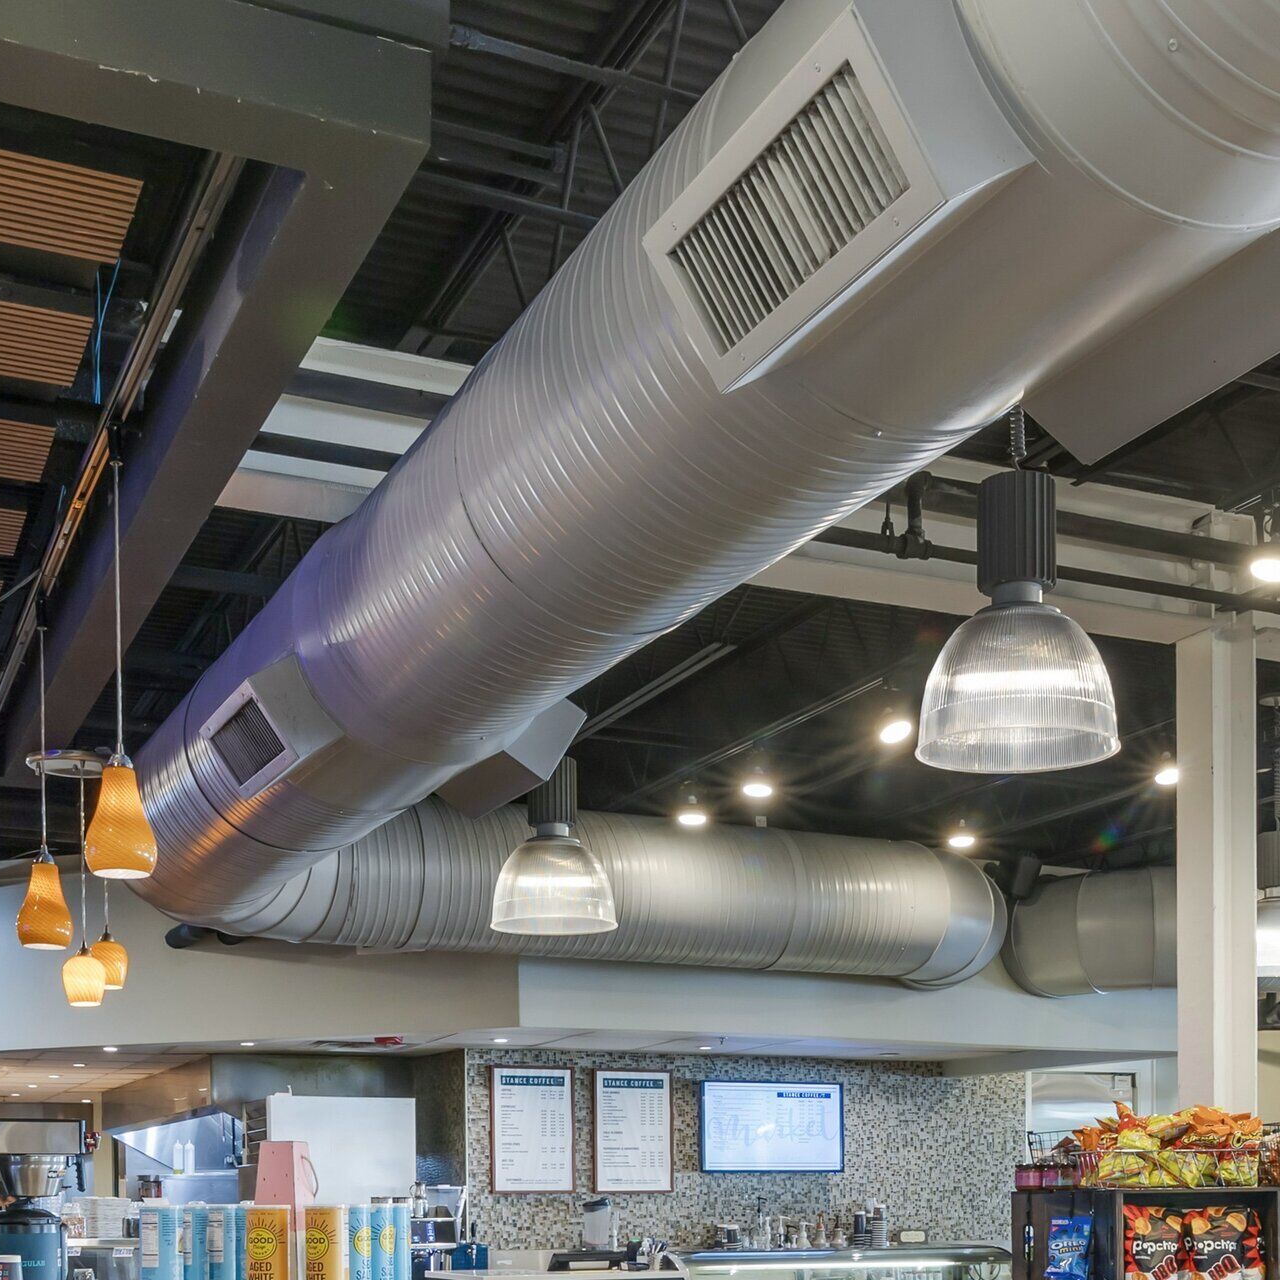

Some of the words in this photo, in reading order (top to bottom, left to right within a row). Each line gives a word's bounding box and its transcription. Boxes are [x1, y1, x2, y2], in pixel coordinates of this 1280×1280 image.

[502, 1077, 527, 1085] STANCE
[249, 1237, 274, 1245] GOOD
[1132, 1240, 1179, 1254] popchip
[249, 1262, 272, 1273] AGED
